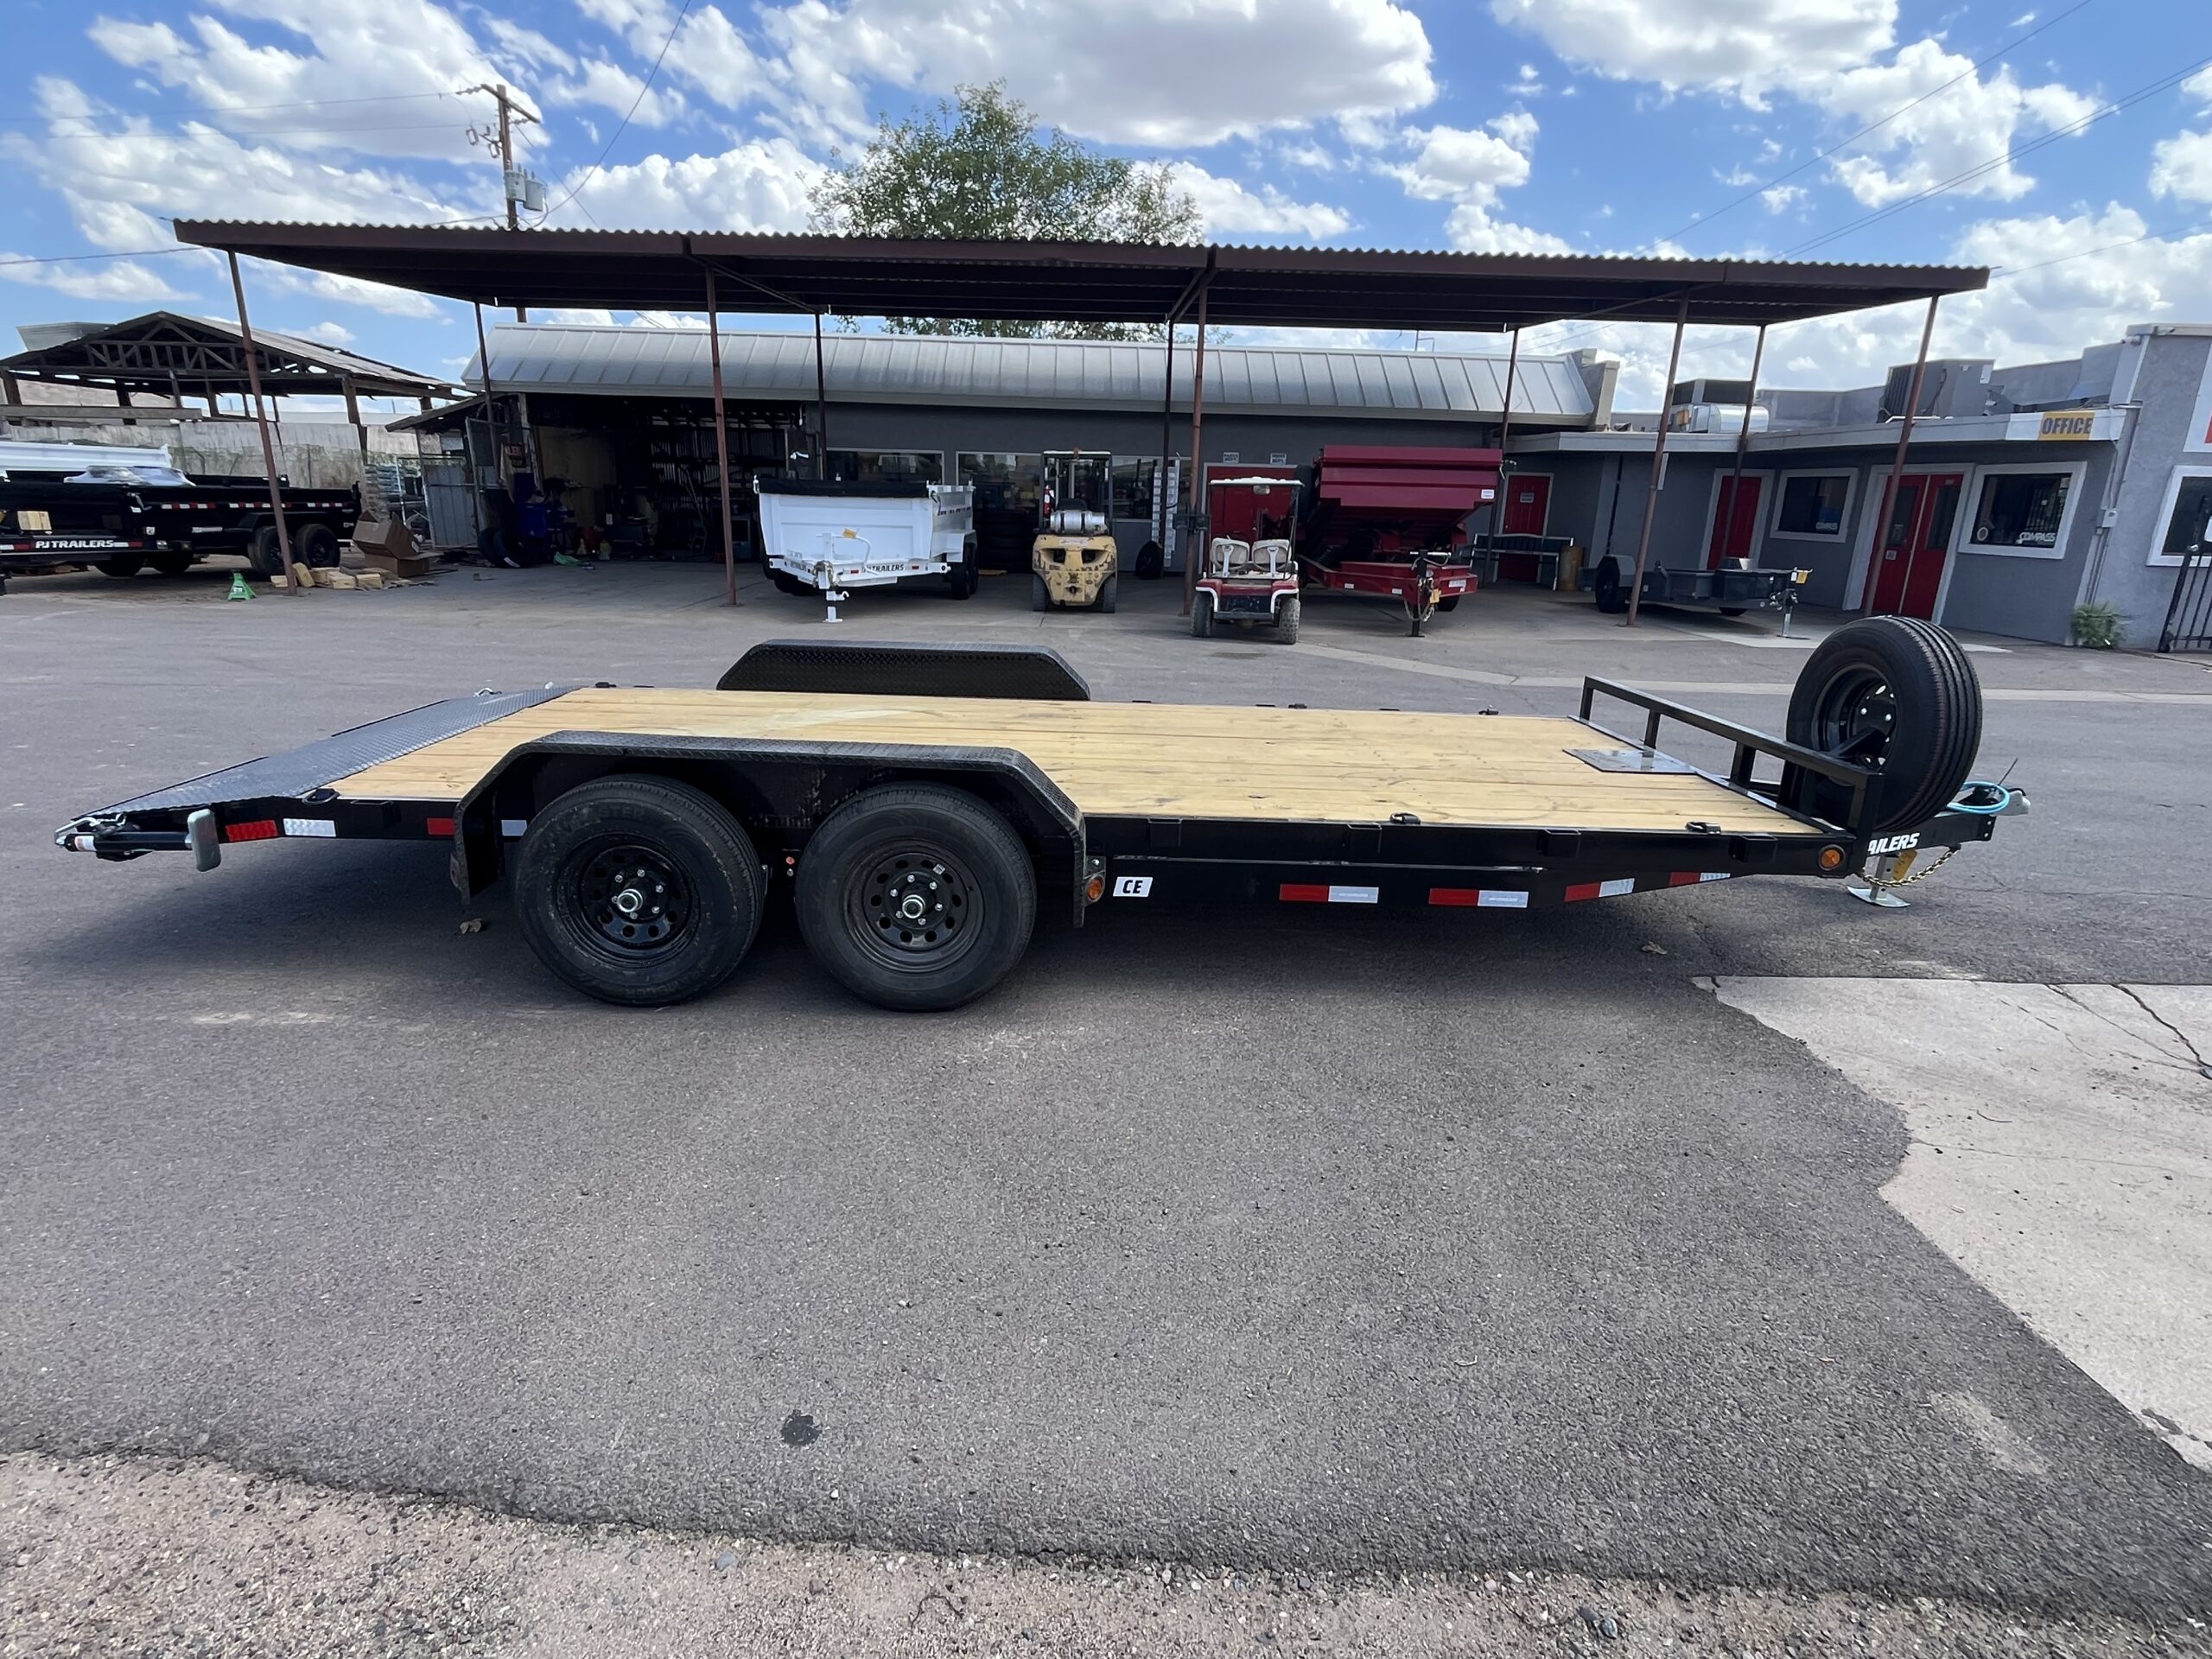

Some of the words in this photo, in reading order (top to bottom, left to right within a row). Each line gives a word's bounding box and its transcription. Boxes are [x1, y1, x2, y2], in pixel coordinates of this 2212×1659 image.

[2041, 416, 2094, 435] OFFICE
[35, 540, 50, 549] PJ
[51, 539, 114, 549] TRAILERS
[1122, 879, 1144, 894] CE
